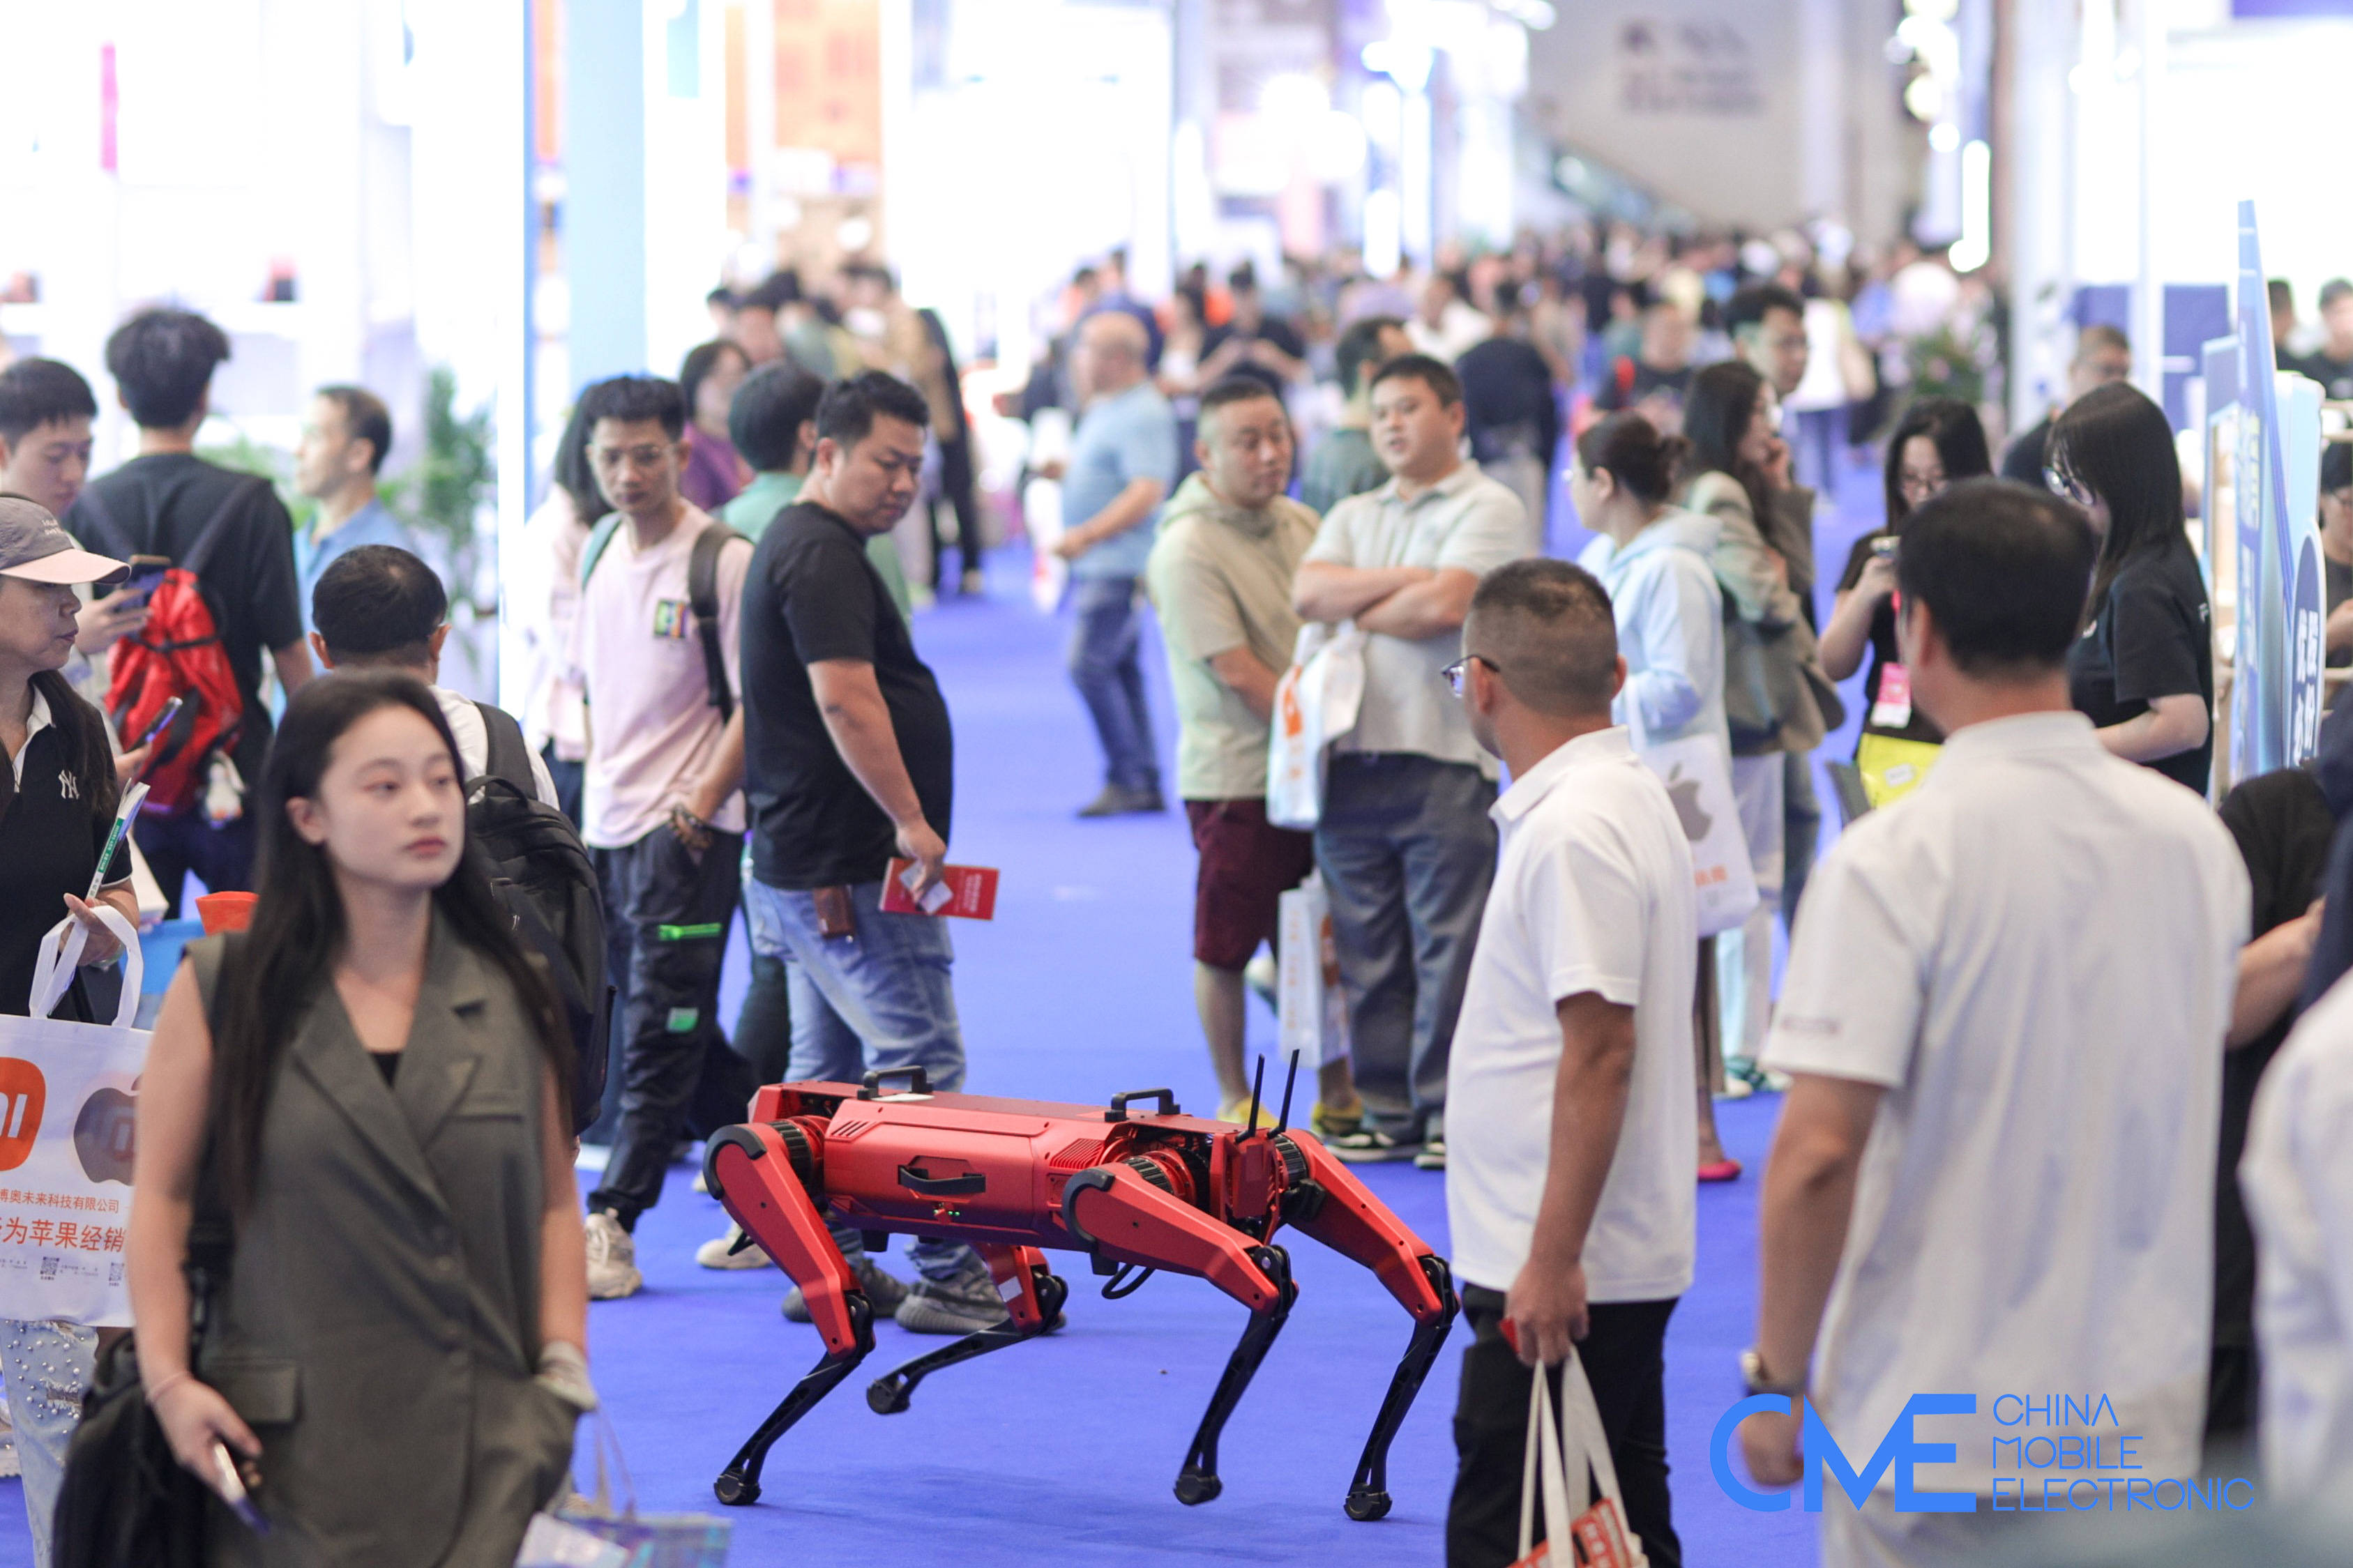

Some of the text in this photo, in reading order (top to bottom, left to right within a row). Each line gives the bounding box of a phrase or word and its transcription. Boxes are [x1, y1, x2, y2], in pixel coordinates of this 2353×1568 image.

[58, 770, 80, 800] NY
[0, 1217, 126, 1253] 为苹果经销
